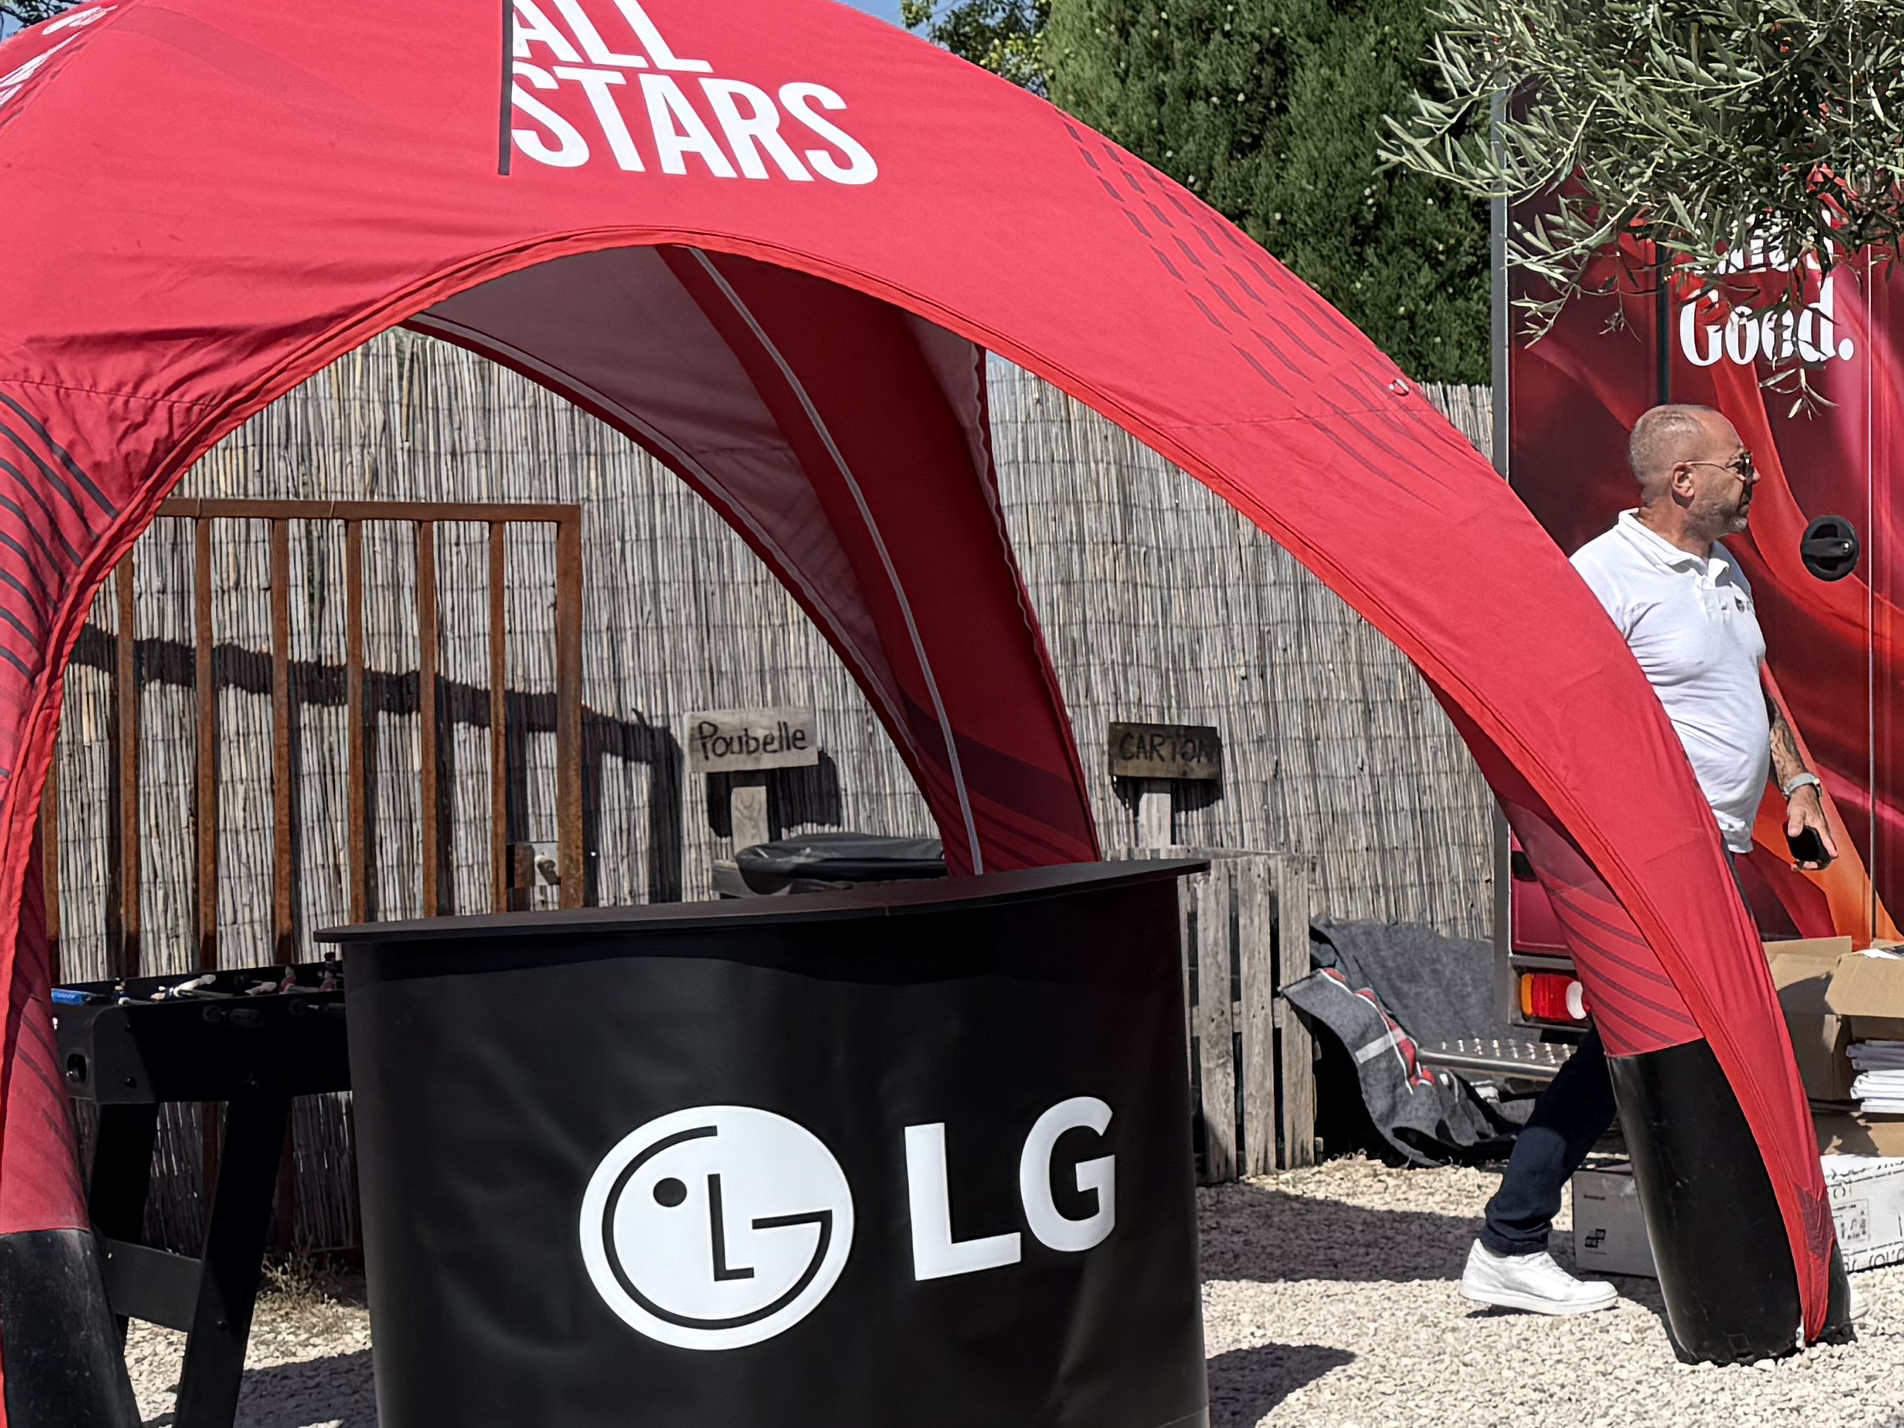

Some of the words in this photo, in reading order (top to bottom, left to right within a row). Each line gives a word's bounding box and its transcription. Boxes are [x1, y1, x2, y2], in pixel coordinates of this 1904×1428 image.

[510, 60, 879, 186] STARS
[1679, 276, 1855, 367] Good.
[697, 720, 809, 761] Poubelle
[904, 1095, 1117, 1281] LG
